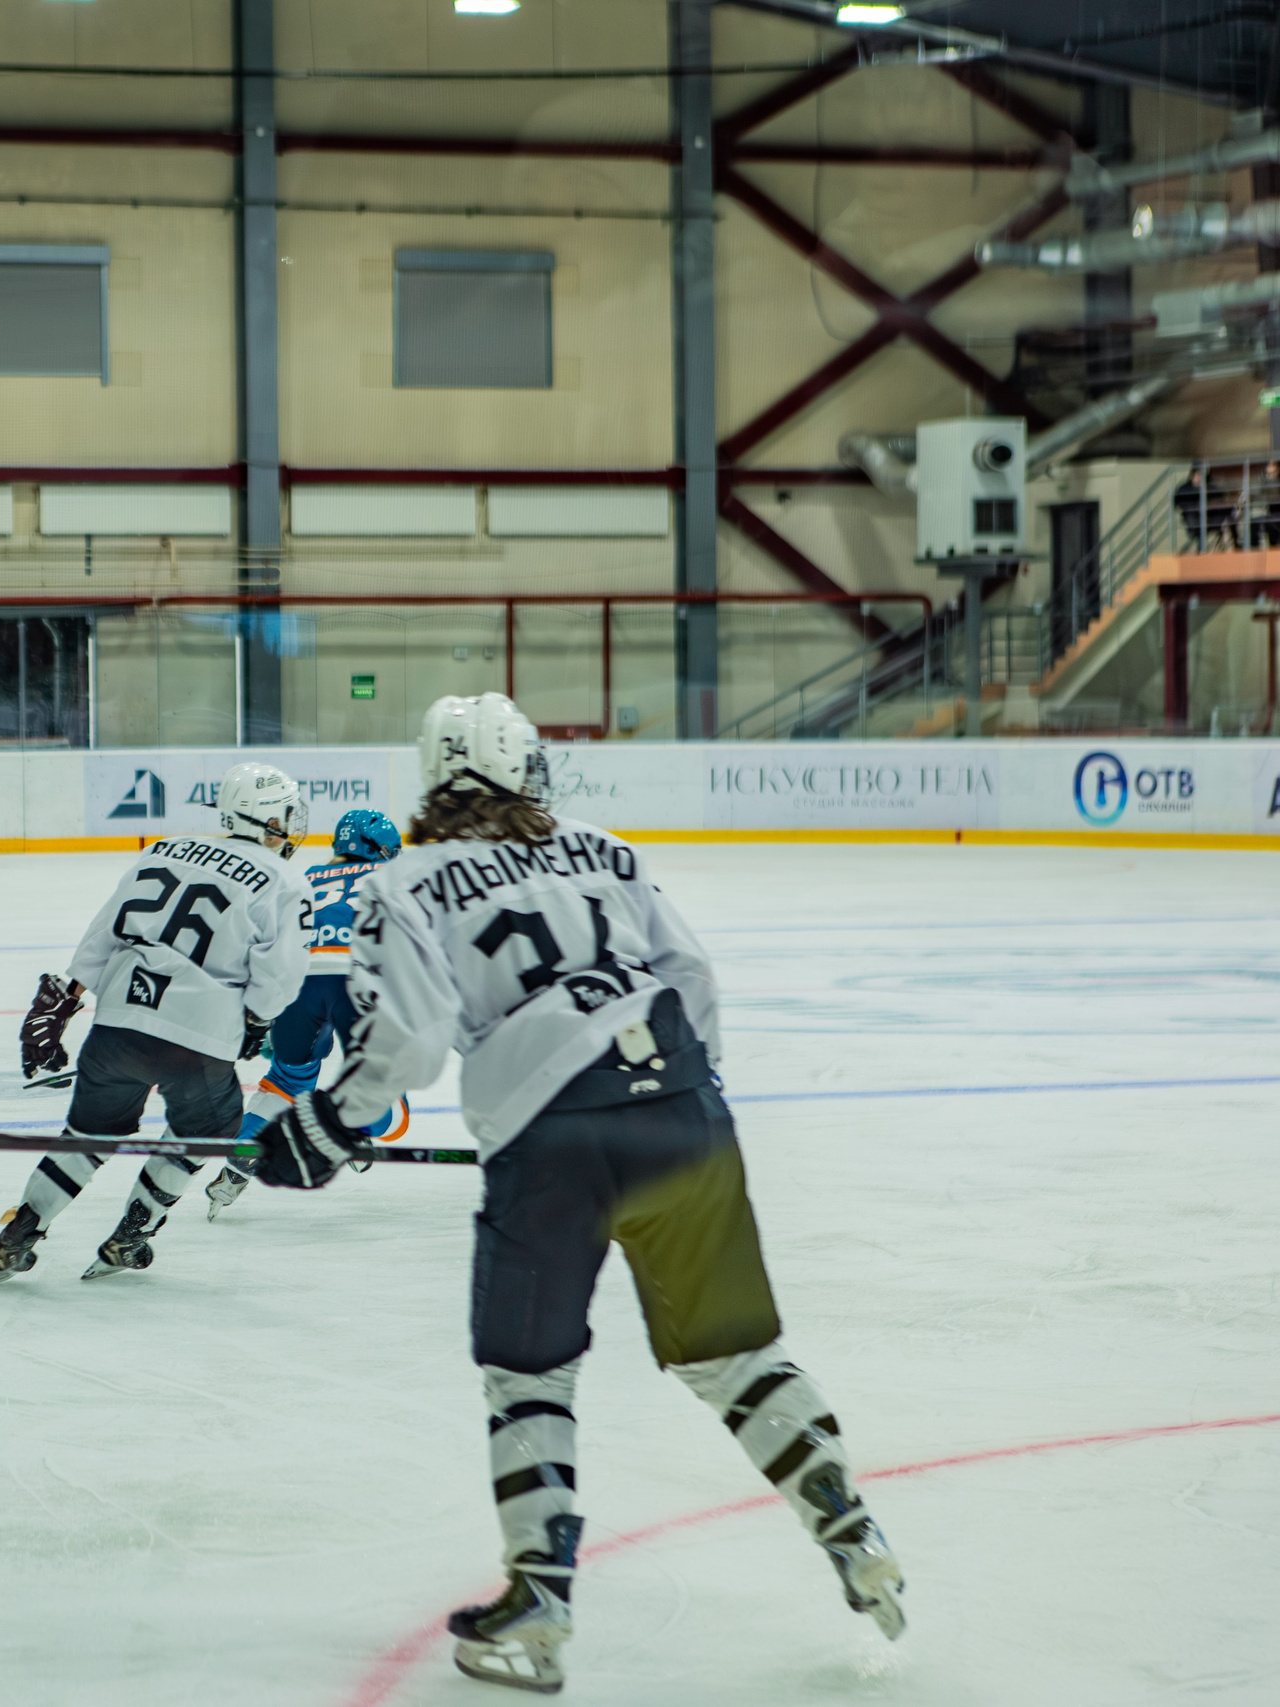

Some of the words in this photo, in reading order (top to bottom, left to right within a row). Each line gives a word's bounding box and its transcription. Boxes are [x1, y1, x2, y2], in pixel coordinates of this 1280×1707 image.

[441, 736, 468, 761] 34
[918, 767, 994, 796] ТЕЛА
[1134, 769, 1194, 799] ОТВ
[339, 827, 350, 840] 55
[113, 867, 231, 968] 26
